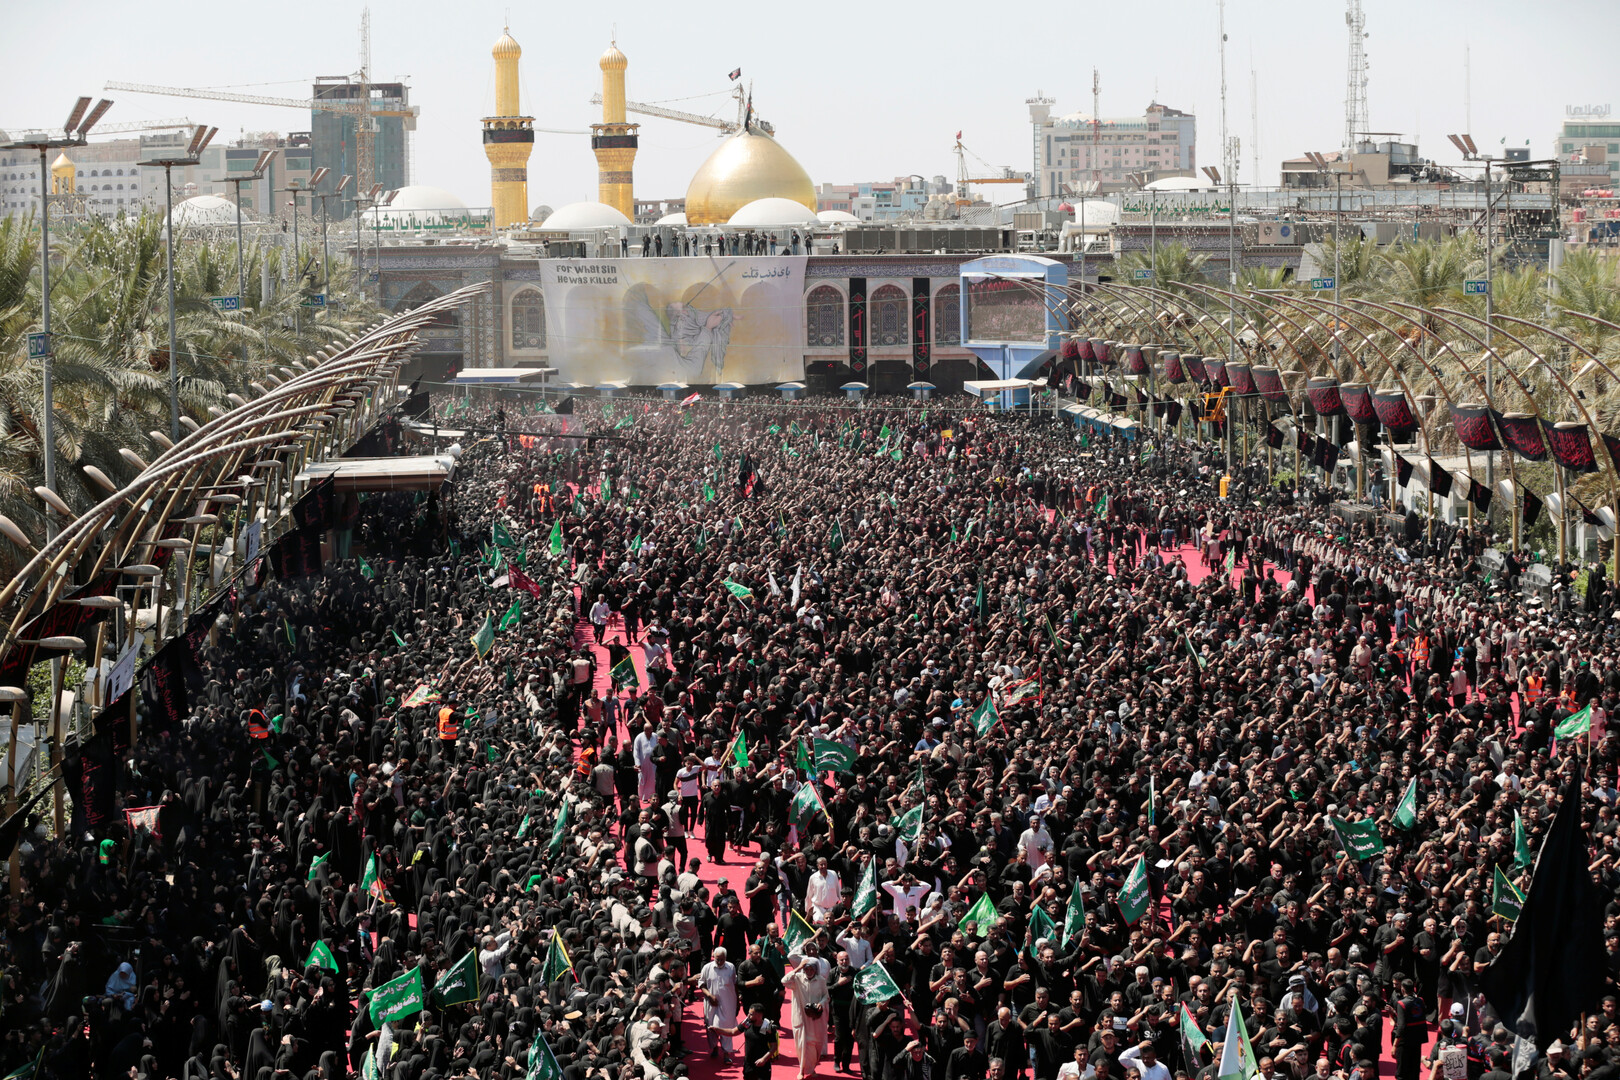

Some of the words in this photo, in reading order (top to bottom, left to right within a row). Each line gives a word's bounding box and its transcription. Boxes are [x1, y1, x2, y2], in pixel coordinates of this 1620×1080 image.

[556, 265, 572, 273] For
[601, 265, 617, 274] Sin
[557, 275, 568, 283] He
[1467, 283, 1475, 292] 62
